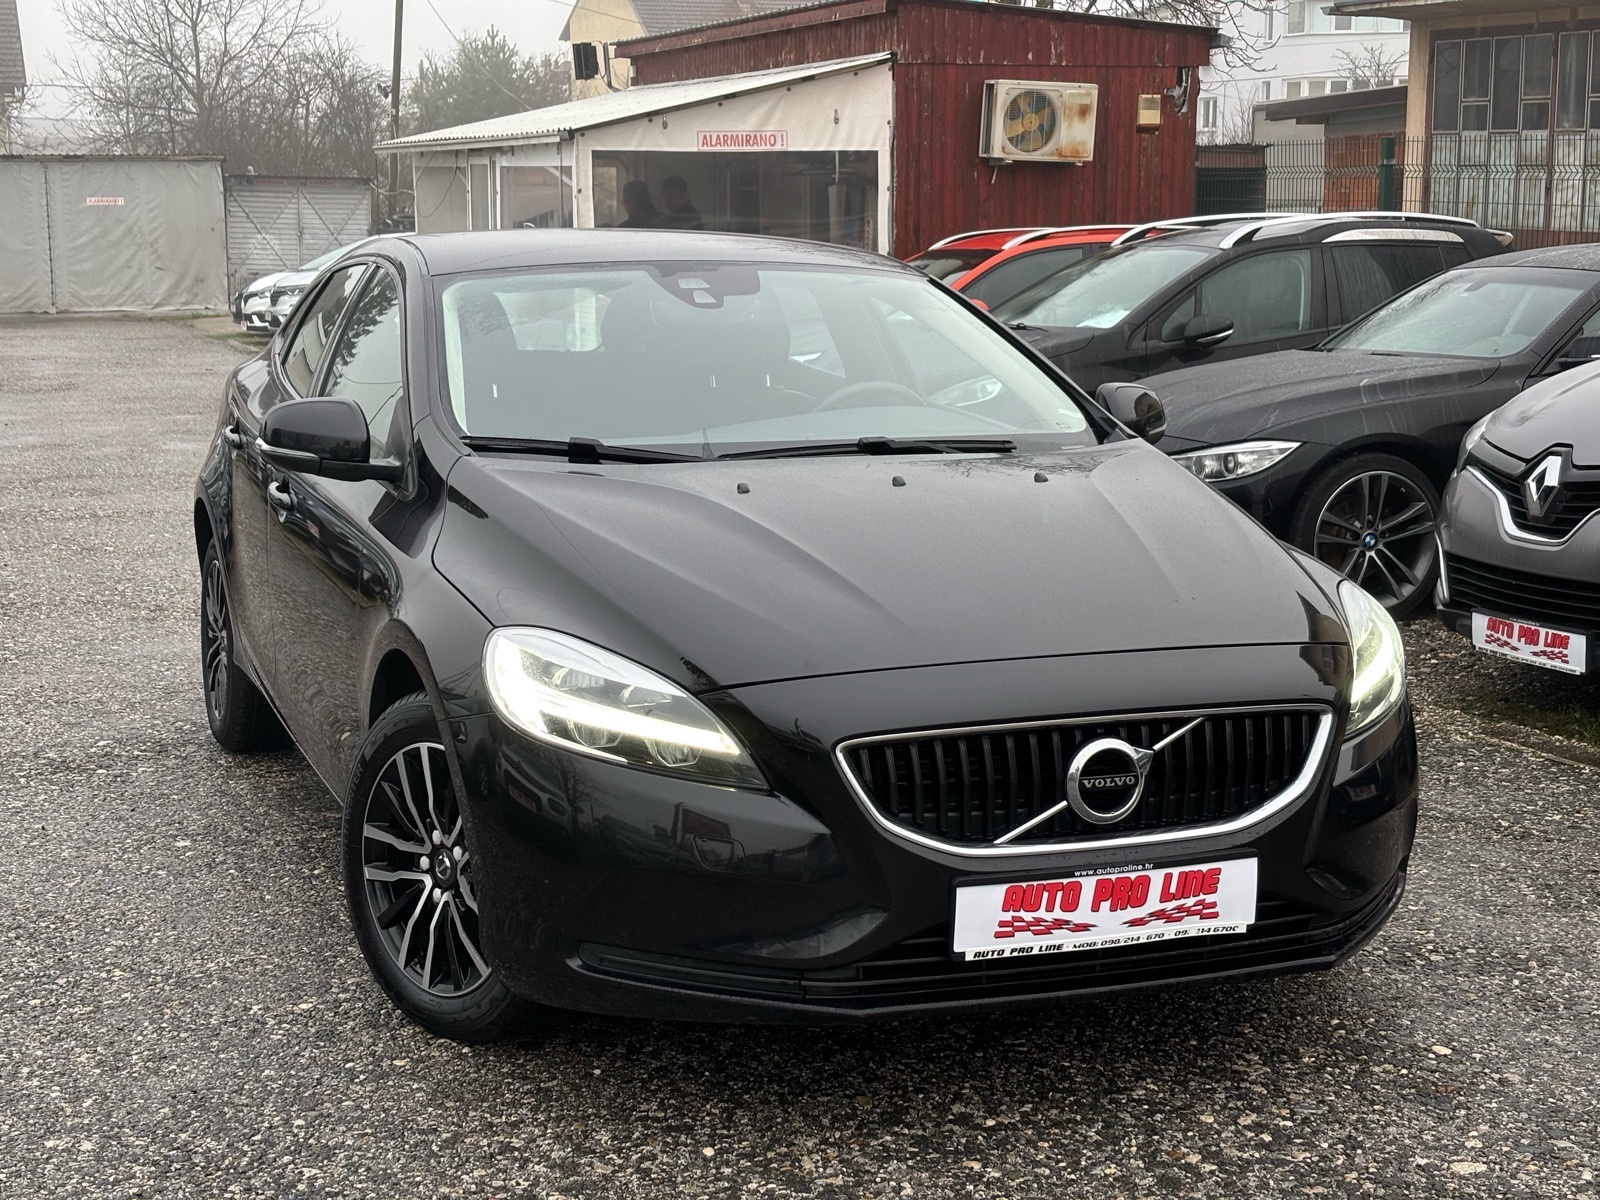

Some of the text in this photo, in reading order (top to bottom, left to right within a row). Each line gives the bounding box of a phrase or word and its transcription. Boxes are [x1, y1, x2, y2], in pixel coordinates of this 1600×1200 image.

[701, 133, 777, 148] ALARMIRANO
[1486, 616, 1571, 650] AUTO PRO LINE
[1082, 776, 1135, 788] VOLVO
[1074, 863, 1154, 877] www.autoproline.hr
[1001, 867, 1222, 913] AUTO PRO LINE
[973, 949, 1006, 959] AUTO
[1009, 946, 1034, 956] PRO
[1038, 943, 1065, 953] LINE
[1072, 940, 1100, 950] MOB:
[1146, 932, 1165, 941] 670
